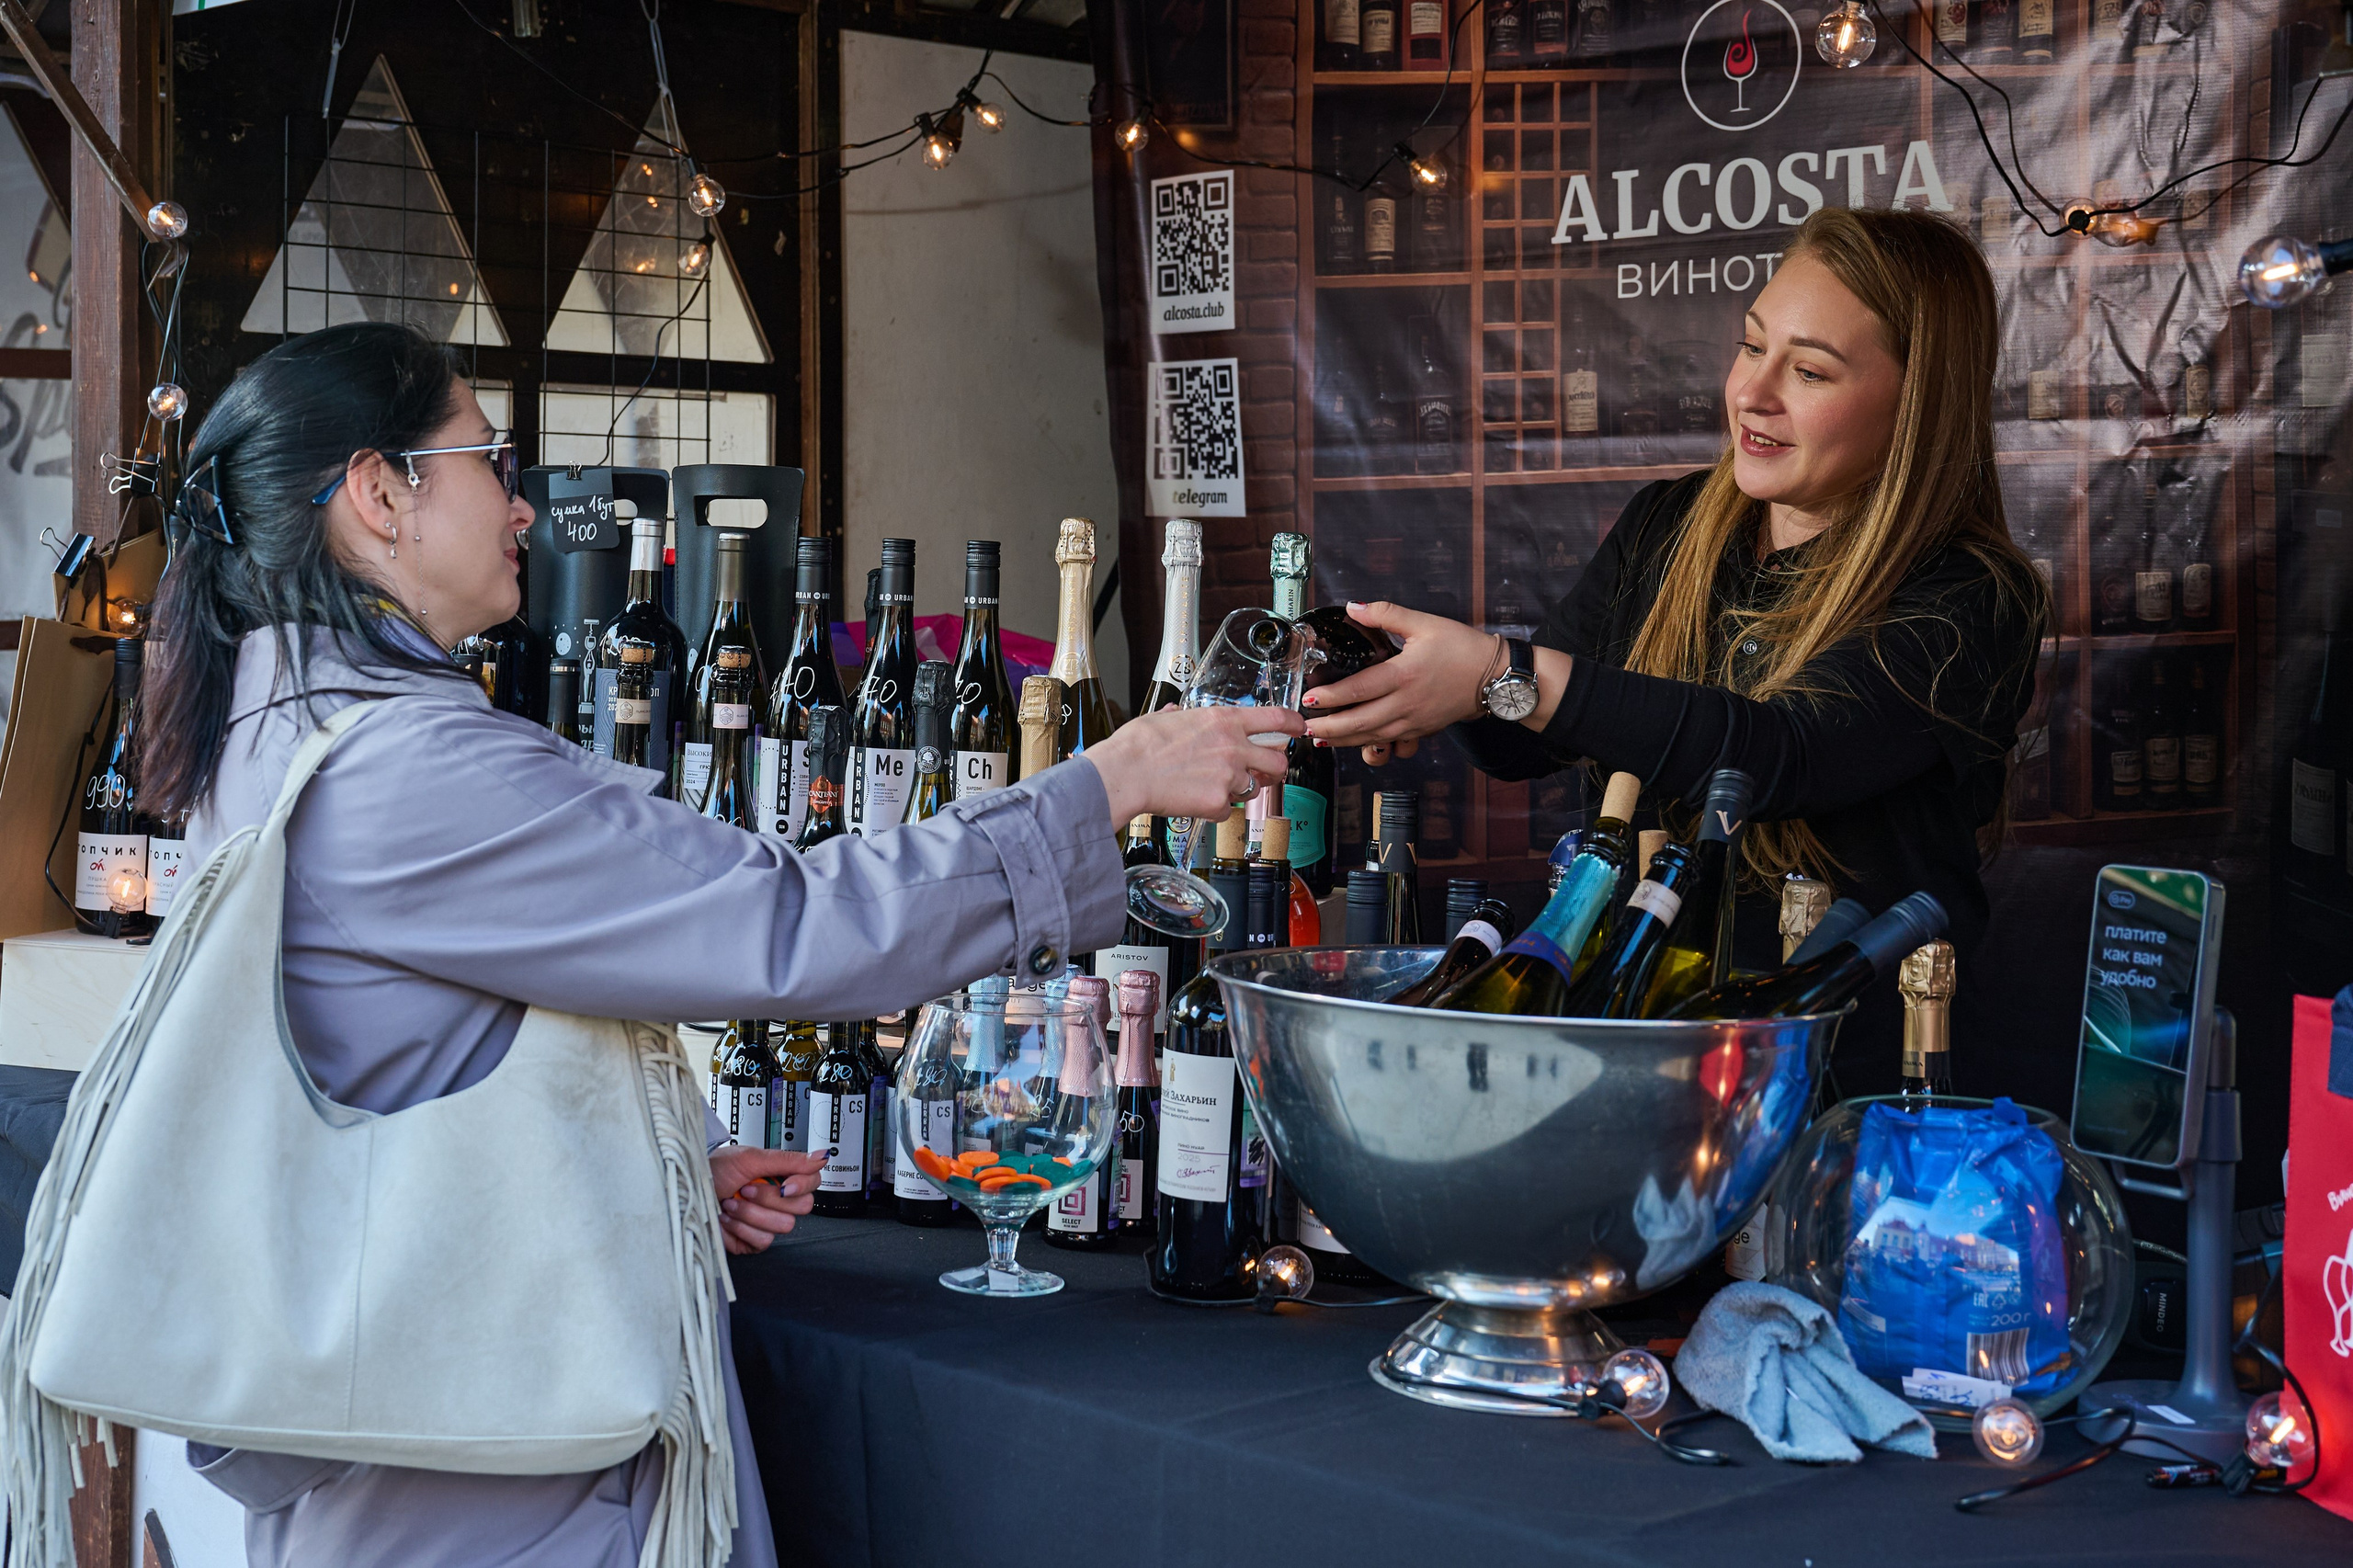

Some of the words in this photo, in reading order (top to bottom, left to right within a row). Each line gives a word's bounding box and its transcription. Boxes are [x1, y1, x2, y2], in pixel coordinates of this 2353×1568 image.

[1551, 140, 1954, 244] ALCOSTA
[1617, 253, 1783, 299] ВИНОТ
[1164, 301, 1224, 322] alcosta.club
[1172, 488, 1228, 507] telegram
[551, 505, 585, 524] сумка
[567, 520, 597, 542] 400
[795, 591, 812, 599] RBAN
[875, 754, 904, 777] Me
[968, 757, 993, 779] Ch
[779, 744, 789, 811] URBAN
[853, 752, 863, 819] URBAN
[85, 774, 126, 810] 990
[78, 844, 137, 857] ОПЧИК
[2105, 925, 2167, 945] платите
[1110, 952, 1149, 961] ARISTOV
[2102, 946, 2130, 963] как
[2132, 949, 2163, 967] вам
[2100, 971, 2157, 989] удобно
[747, 1093, 763, 1107] CS
[848, 1100, 863, 1113] CS
[936, 1106, 950, 1118] CS
[832, 1164, 860, 1172] СОВИНЬОН
[1062, 1217, 1081, 1225] SELECT
[2156, 1292, 2167, 1333] MINDEO
